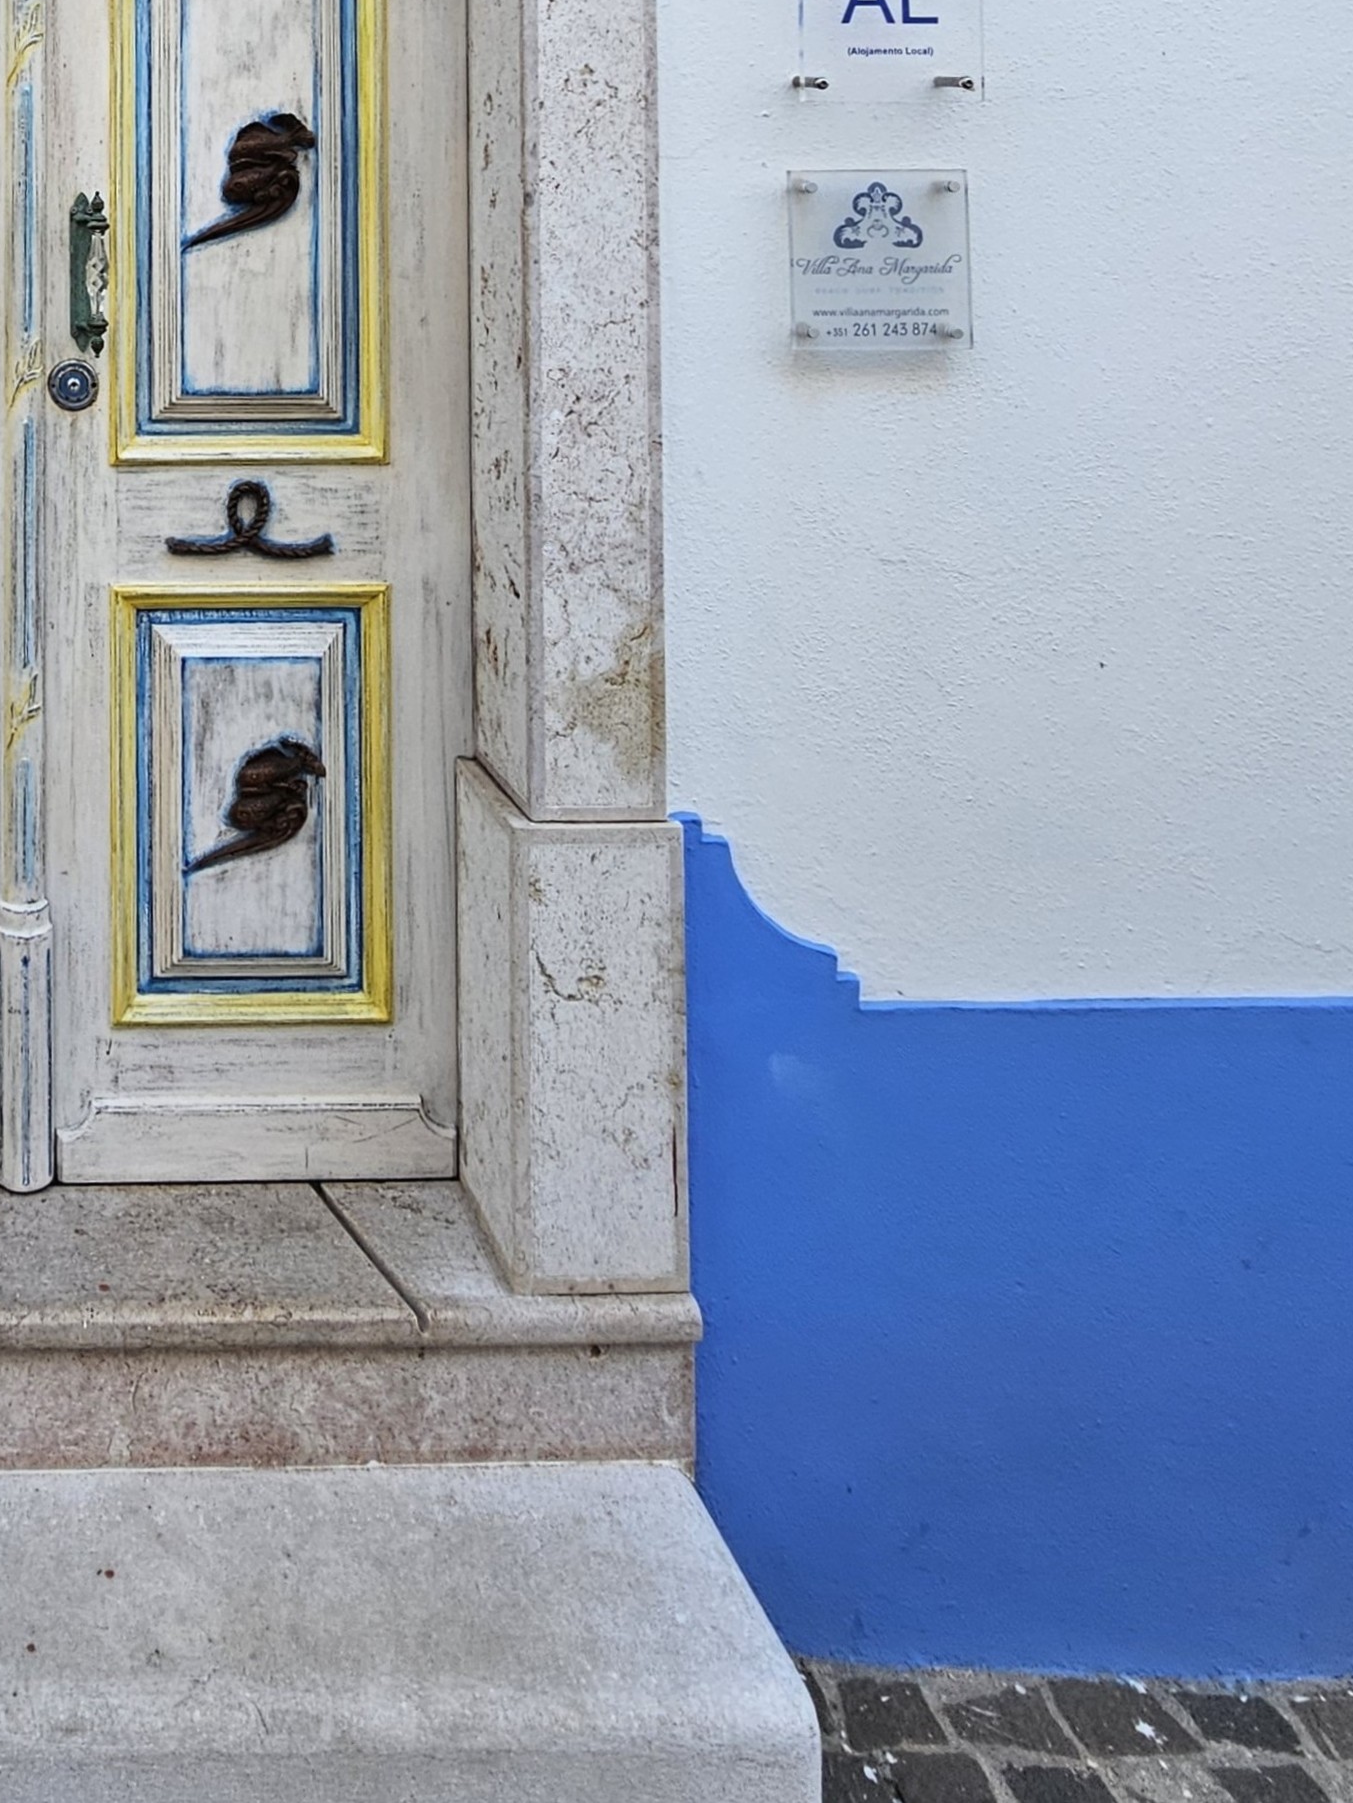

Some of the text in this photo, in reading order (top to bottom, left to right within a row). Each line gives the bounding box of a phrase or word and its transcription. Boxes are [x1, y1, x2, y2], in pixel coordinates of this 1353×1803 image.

[847, 47, 934, 57] (Alojamento Local)
[796, 254, 962, 285] Villa Ana Margarida
[812, 307, 950, 319] www.villaanamargarida.com
[826, 322, 938, 337] +351 261 243 874
